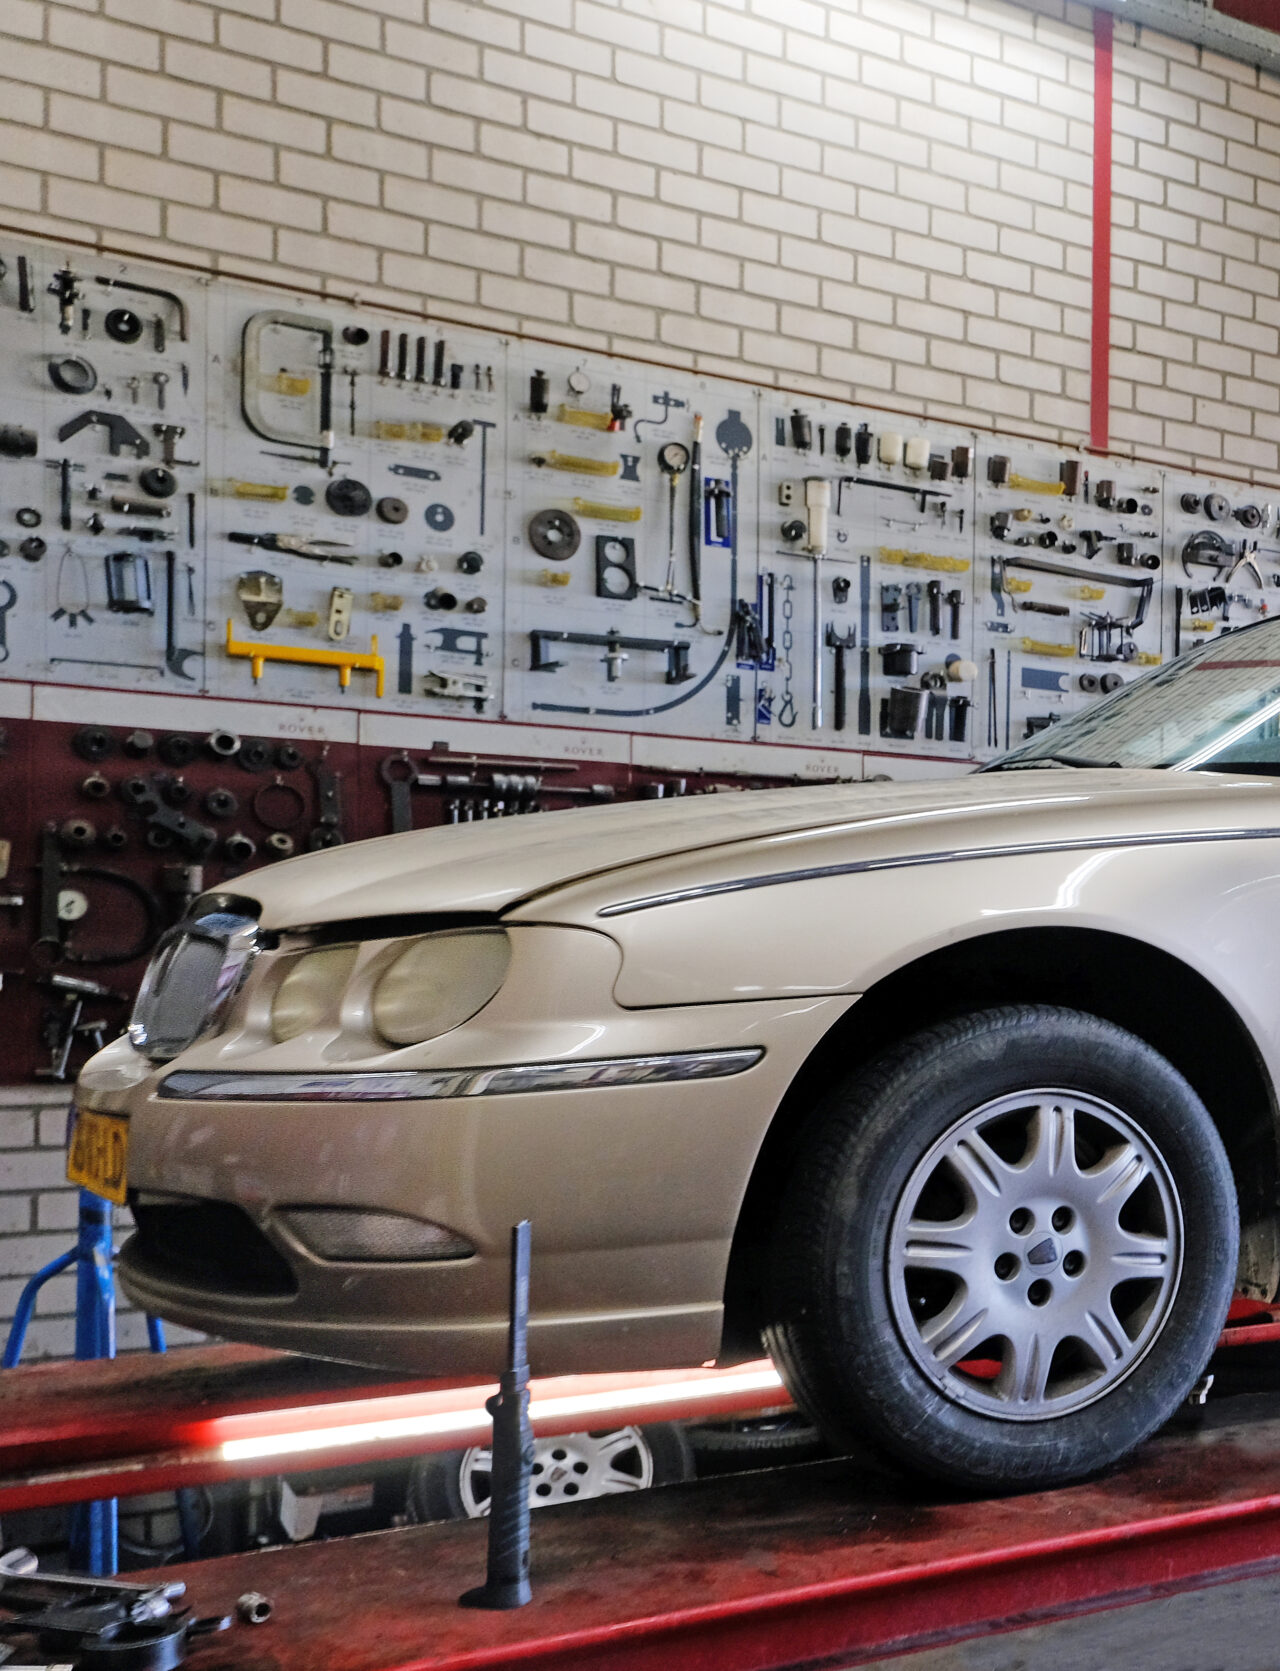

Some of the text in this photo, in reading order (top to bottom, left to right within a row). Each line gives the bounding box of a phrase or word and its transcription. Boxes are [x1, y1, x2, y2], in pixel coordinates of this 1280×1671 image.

[278, 722, 326, 736] ROVER
[563, 745, 604, 757] ROVER
[805, 763, 840, 775] ROVER
